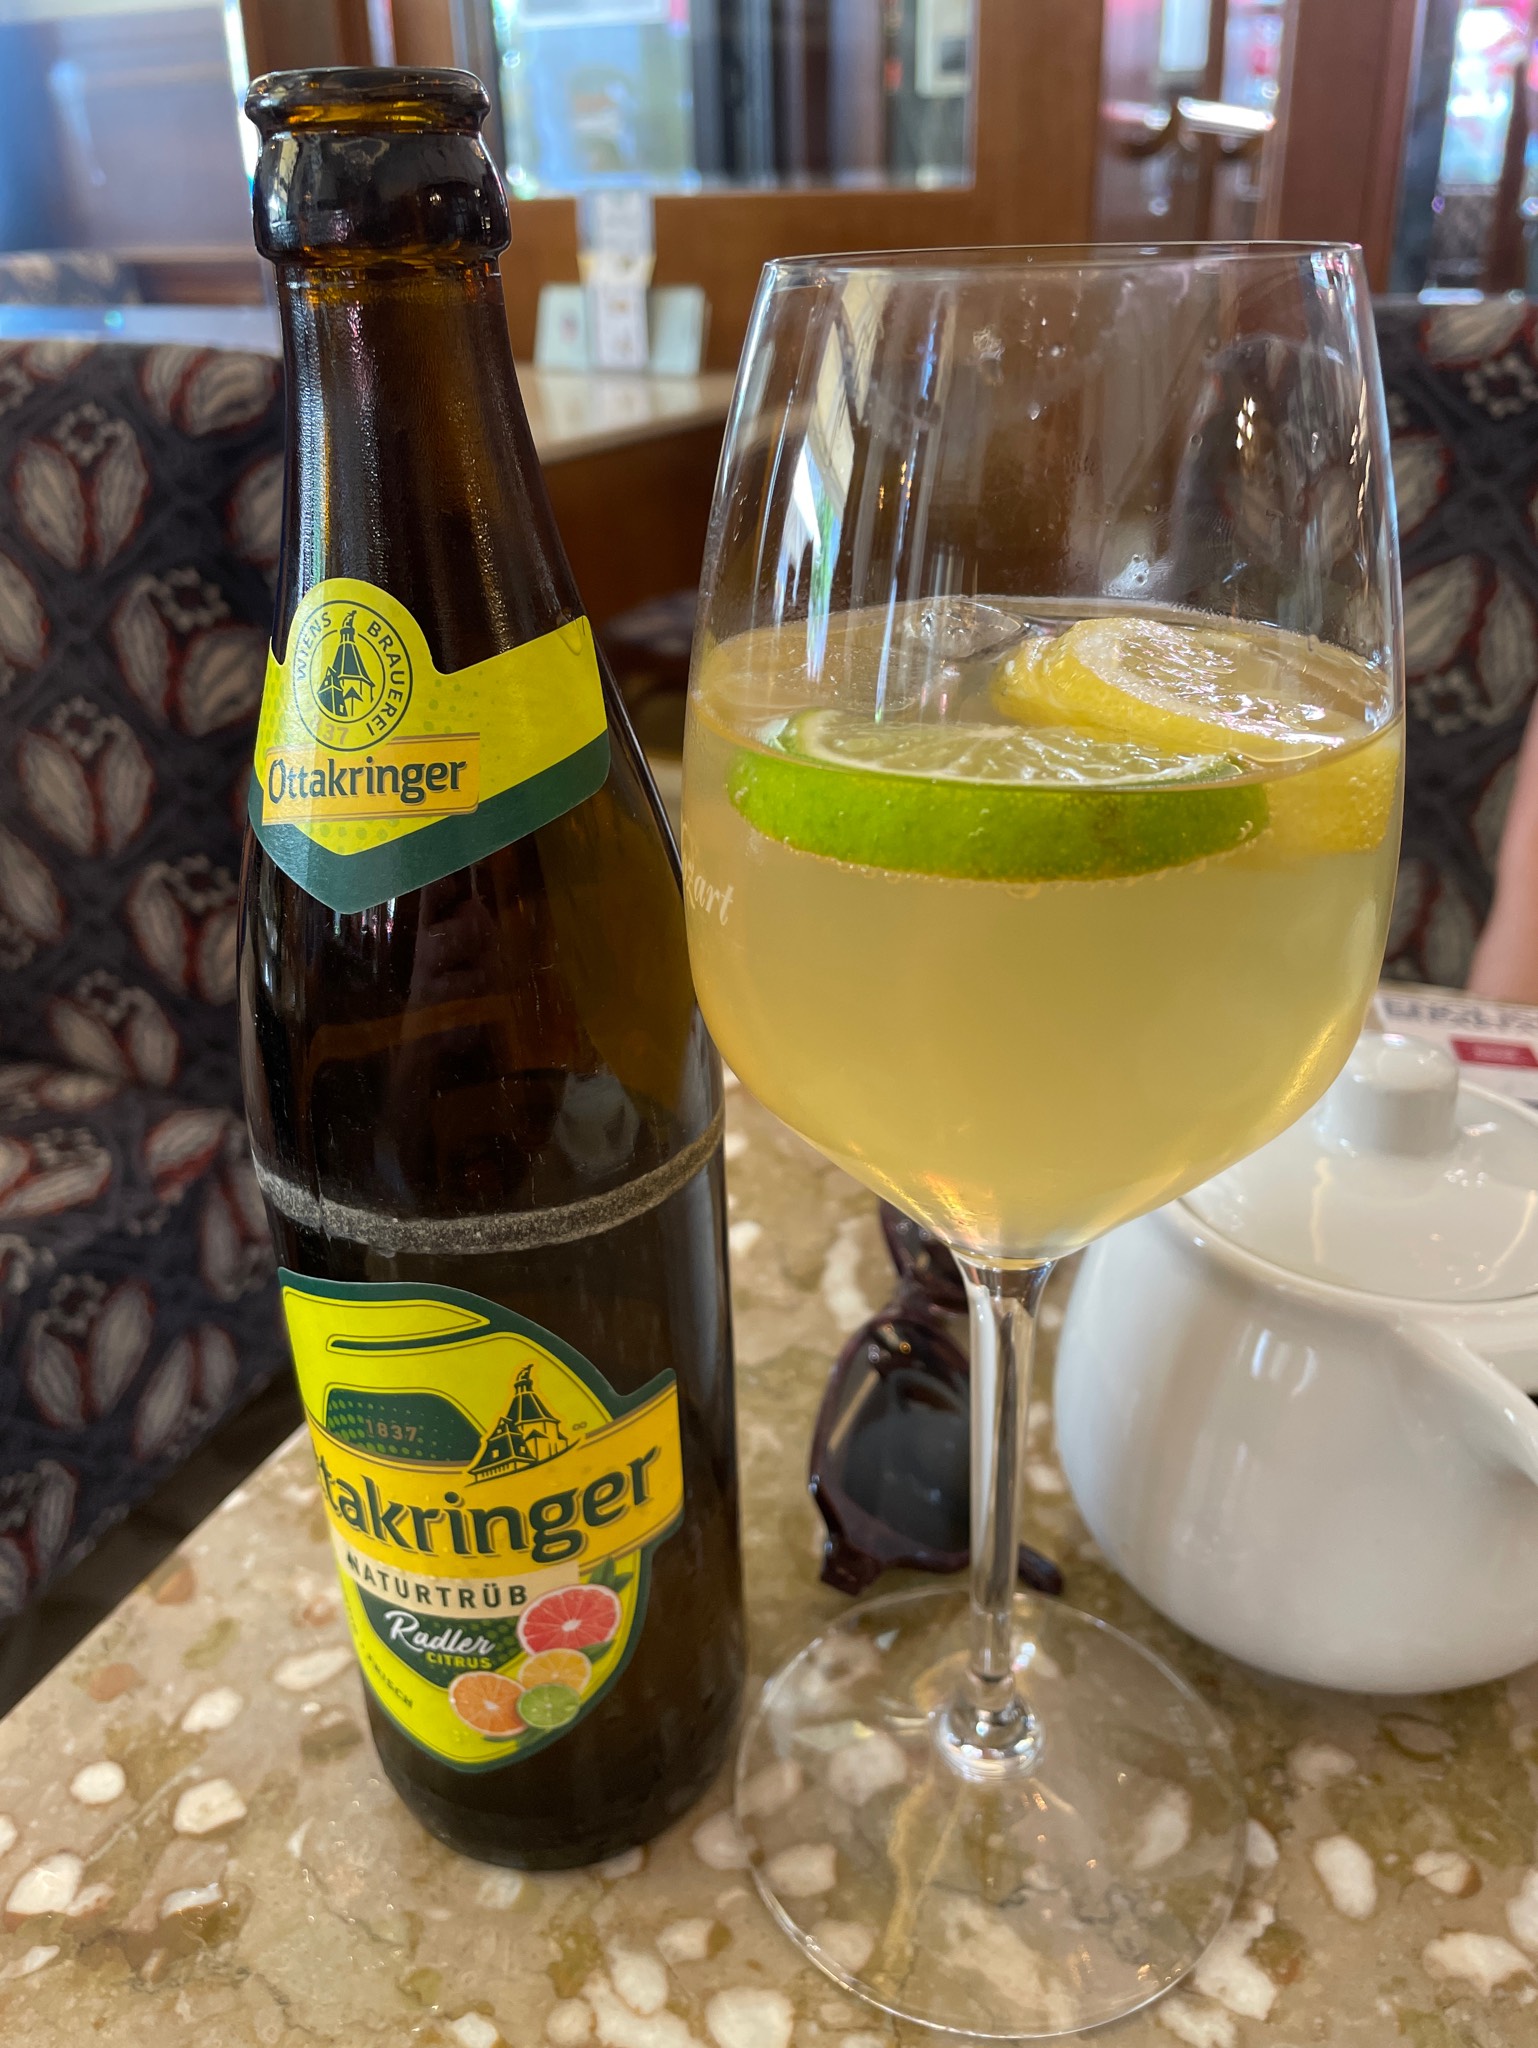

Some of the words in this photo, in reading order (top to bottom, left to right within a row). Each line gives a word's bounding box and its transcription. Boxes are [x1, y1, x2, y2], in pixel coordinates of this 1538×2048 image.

[297, 611, 332, 680] WIENS
[366, 620, 407, 737] BRAUEREI
[268, 756, 468, 805] Ottakringer
[366, 1418, 418, 1442] 1837
[318, 1447, 662, 1563] takringer
[347, 1549, 529, 1610] NATURTRÜB
[384, 1610, 496, 1657] Radler
[426, 1651, 493, 1670] CITRUS
